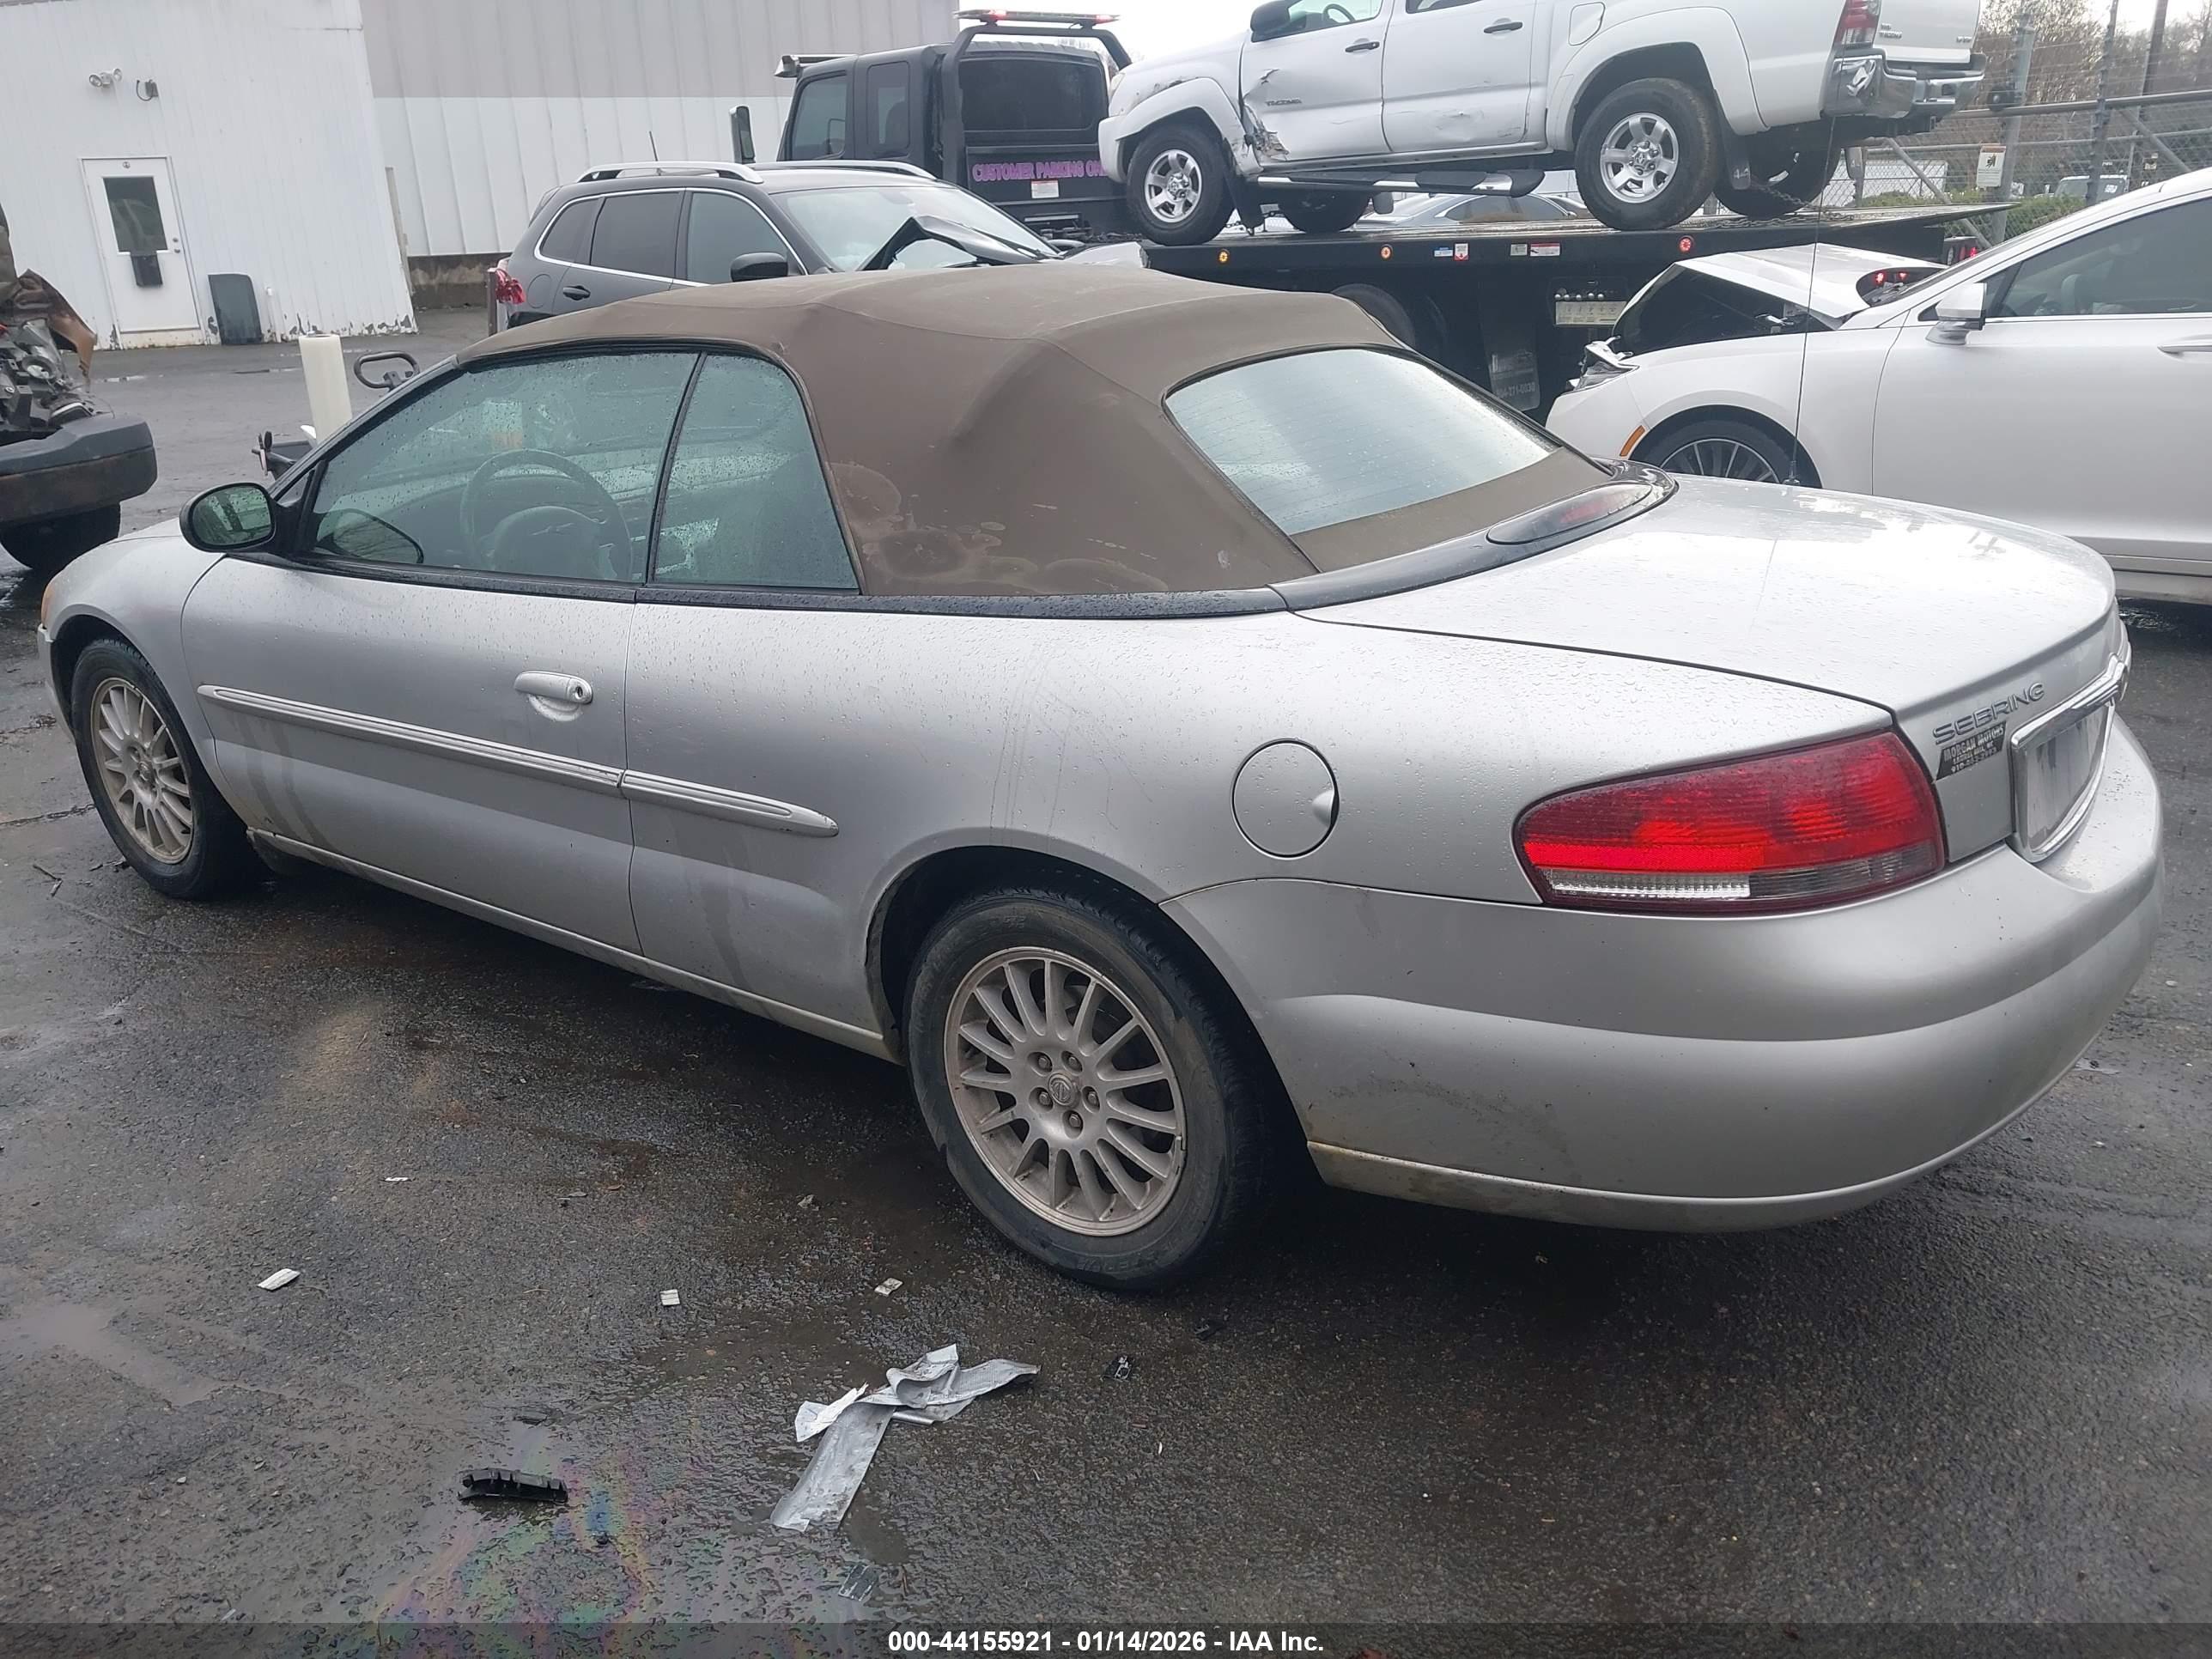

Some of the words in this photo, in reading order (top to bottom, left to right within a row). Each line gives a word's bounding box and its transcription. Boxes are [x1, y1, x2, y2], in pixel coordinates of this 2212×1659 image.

[972, 162, 1035, 182] CUSTOMER
[1036, 161, 1085, 179] PARKING
[1085, 160, 1109, 177] ONL
[1932, 683, 2045, 744] SEBRING
[1943, 737, 1977, 762] MORGAN
[1978, 724, 2004, 745] MOTORS
